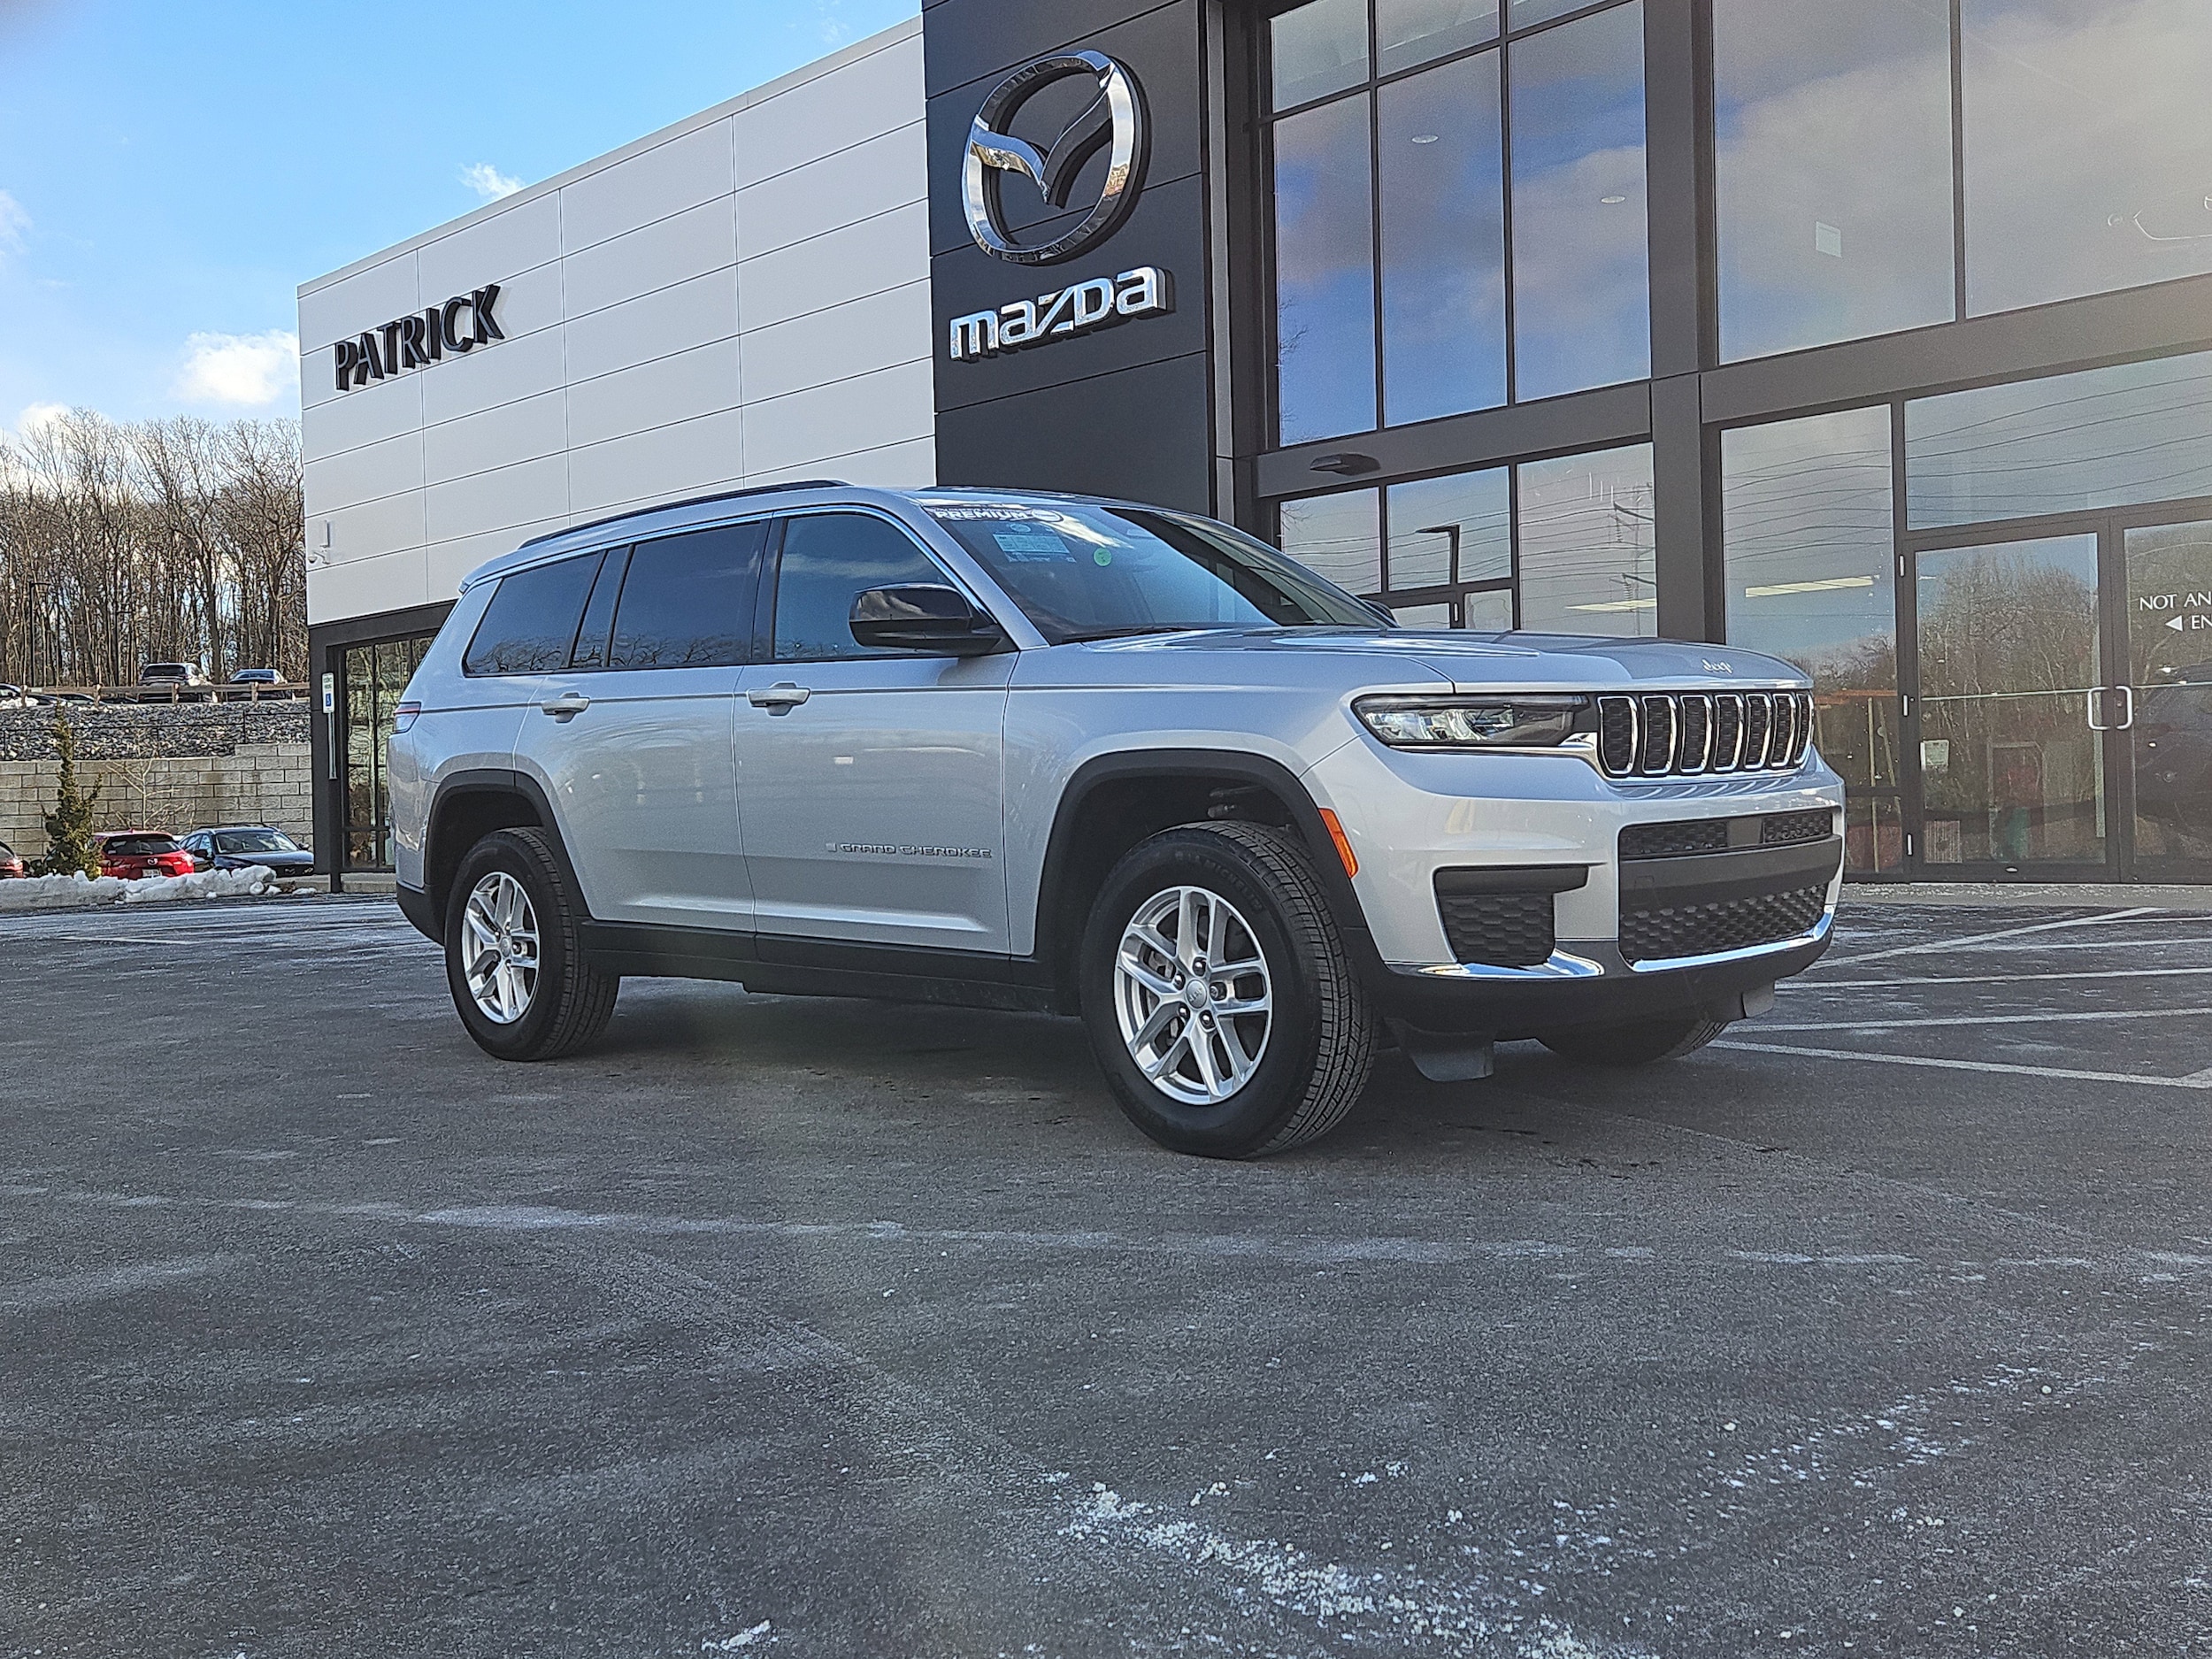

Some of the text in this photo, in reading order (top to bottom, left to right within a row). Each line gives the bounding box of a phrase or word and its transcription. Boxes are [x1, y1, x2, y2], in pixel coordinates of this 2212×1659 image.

[334, 283, 505, 391] PATRICK
[2139, 591, 2212, 611] NOT AN
[841, 843, 993, 858] GRAND CHEROKEE
